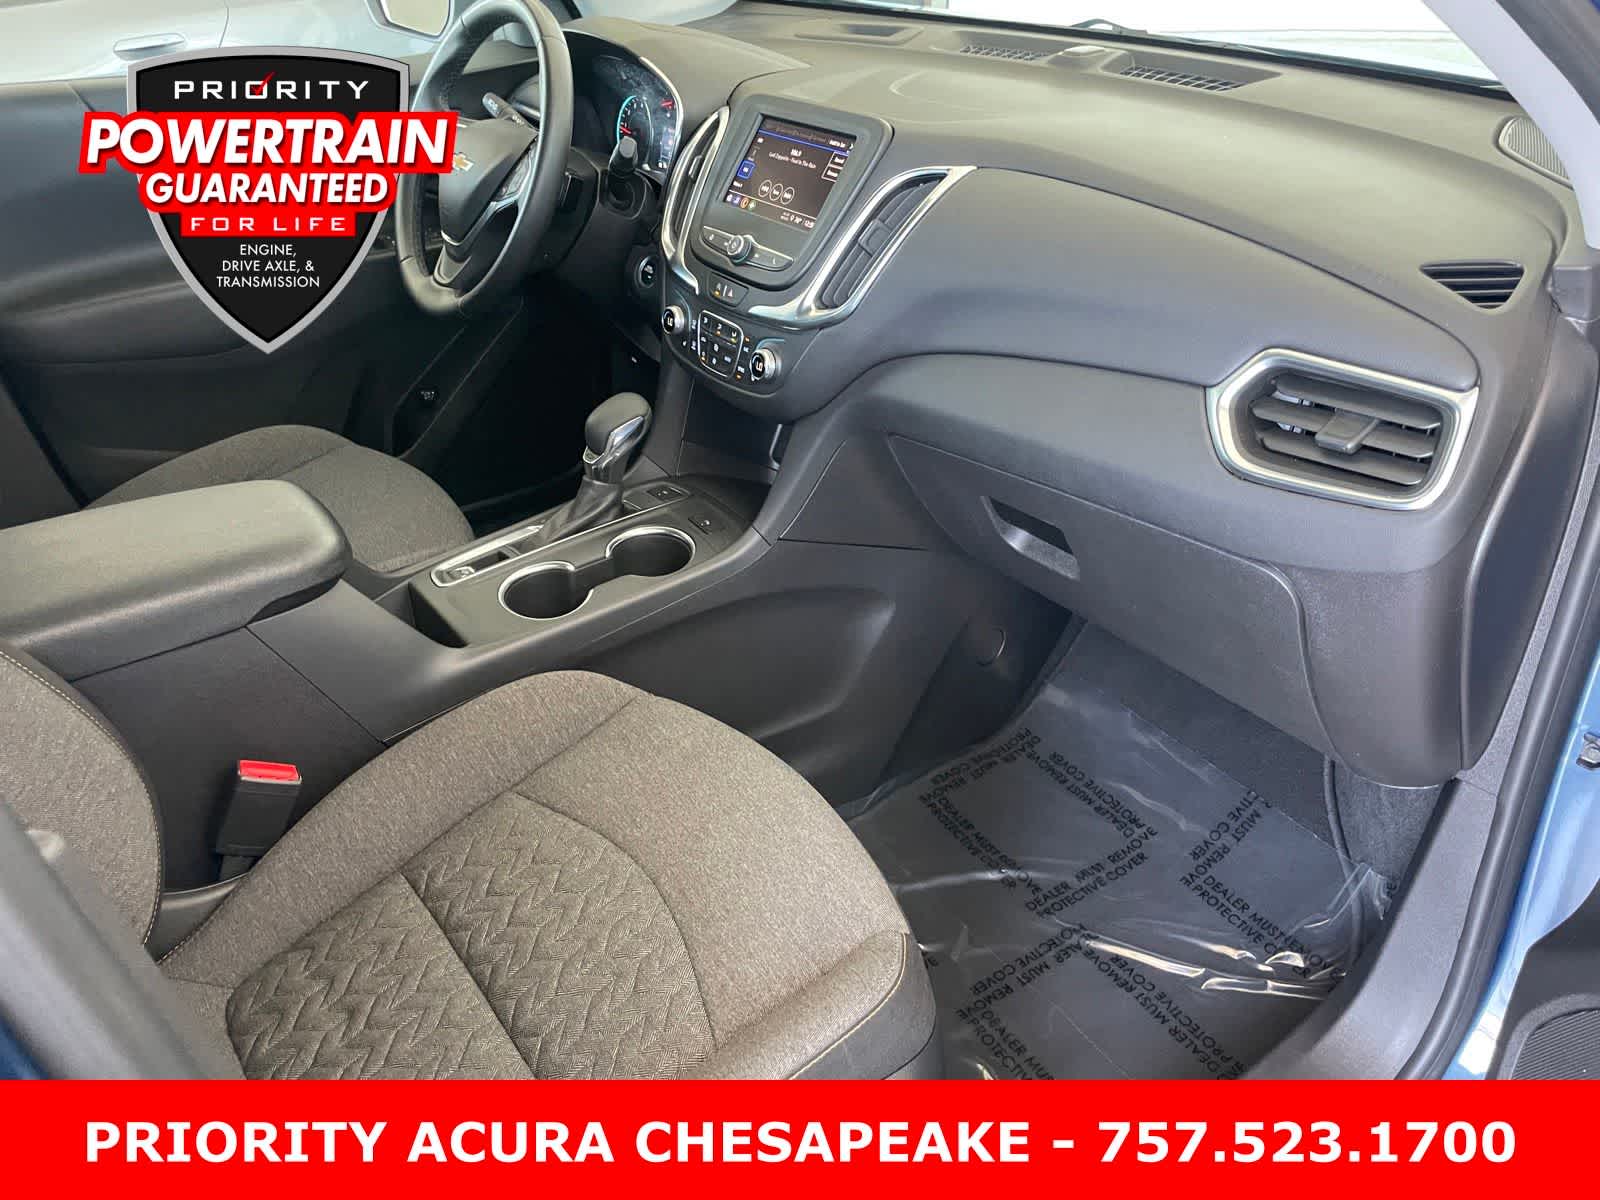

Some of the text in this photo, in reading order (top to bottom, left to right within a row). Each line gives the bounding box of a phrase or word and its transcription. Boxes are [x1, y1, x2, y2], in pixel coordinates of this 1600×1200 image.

[1024, 880, 1073, 913] DEALER
[1106, 825, 1160, 866] REMOVE
[1179, 809, 1262, 888] MUST REMOVE
[1189, 821, 1230, 861] COVER
[1035, 851, 1150, 919] PROTECTIVE COVER
[1191, 883, 1264, 944] PROTECTIVE
[1203, 875, 1250, 914] DEALER
[1248, 912, 1285, 941] MUST
[955, 983, 1014, 1020] REMOVE
[970, 963, 1016, 996] COVER
[1016, 960, 1051, 986] MUST
[1082, 948, 1221, 1074] DEALER MUST REMOVE
[1109, 954, 1234, 1063] PROTECTIVE COVER
